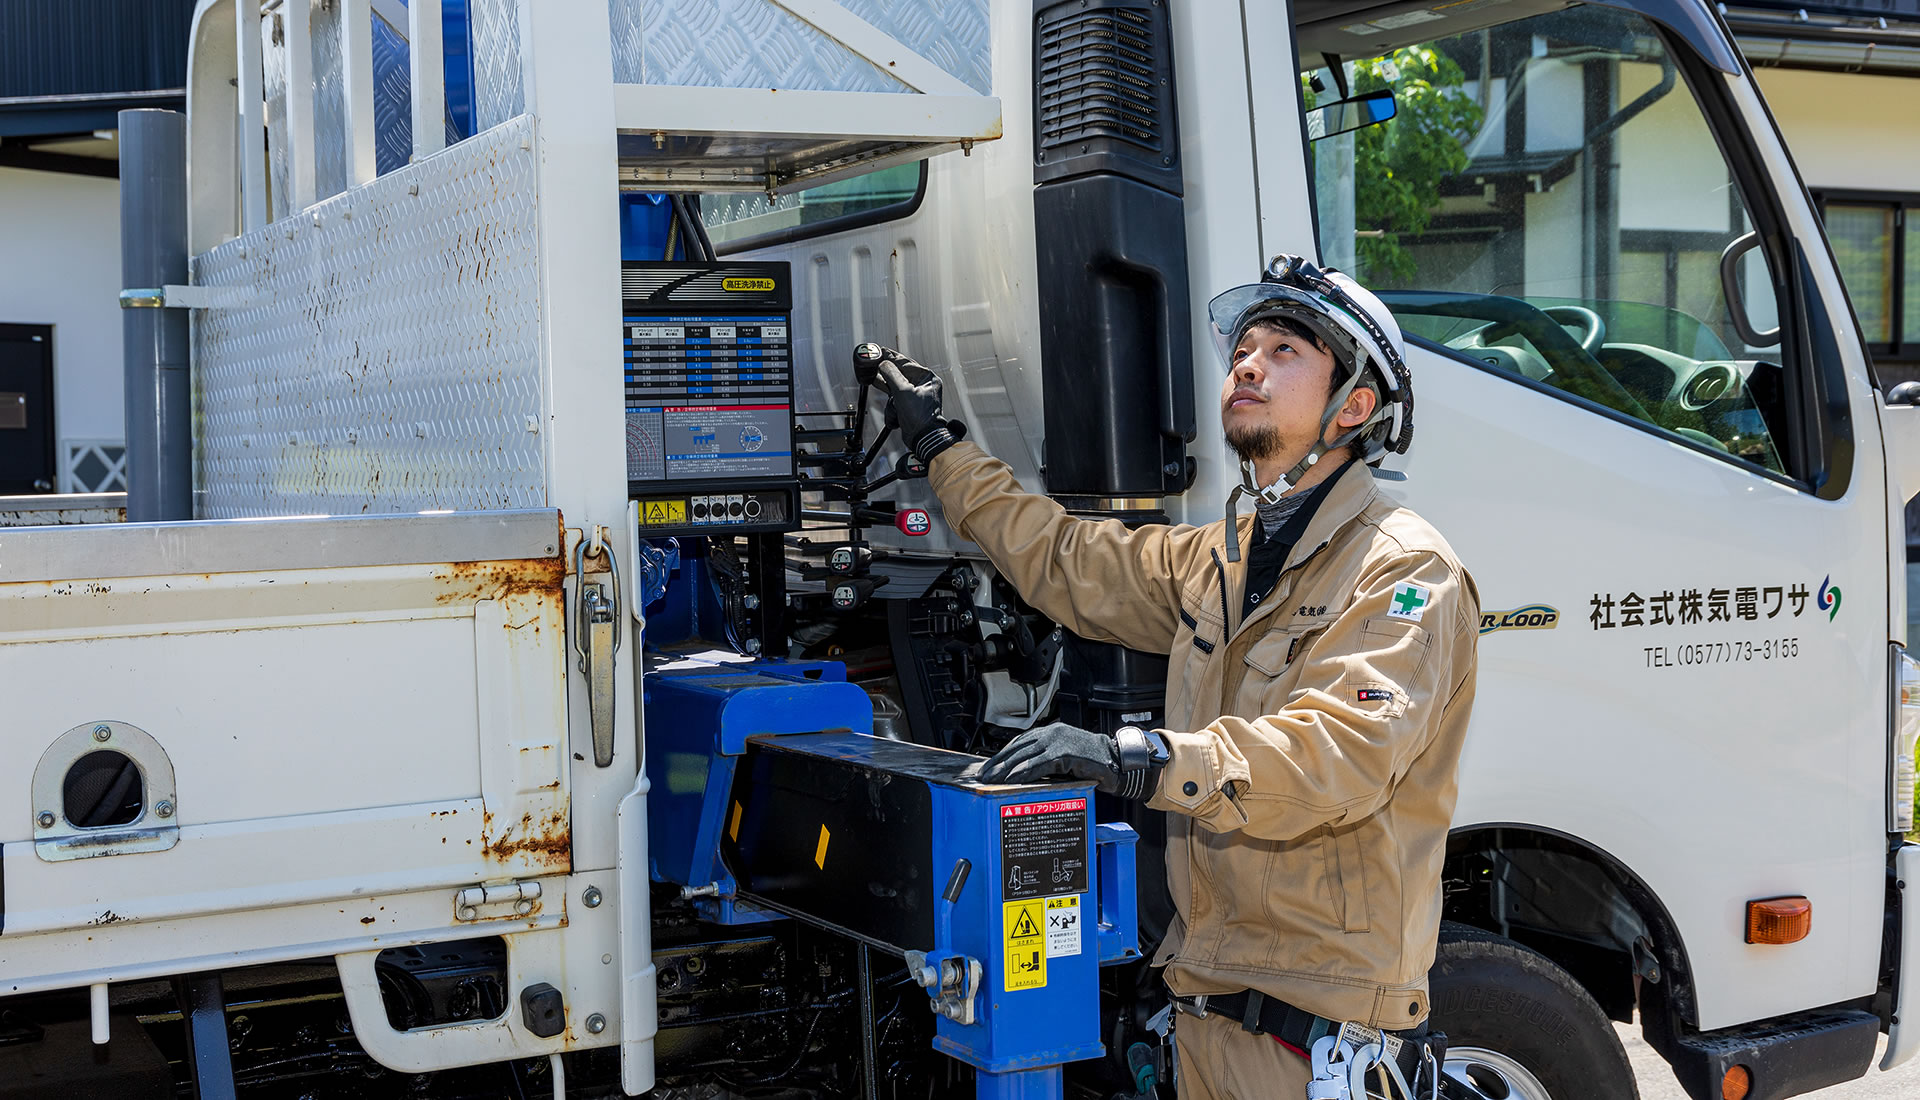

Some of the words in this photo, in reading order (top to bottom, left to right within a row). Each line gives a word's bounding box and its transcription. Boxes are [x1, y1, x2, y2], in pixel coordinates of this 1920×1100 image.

[726, 280, 772, 289] 高圧洗浄禁止
[1501, 613, 1557, 627] LOOP
